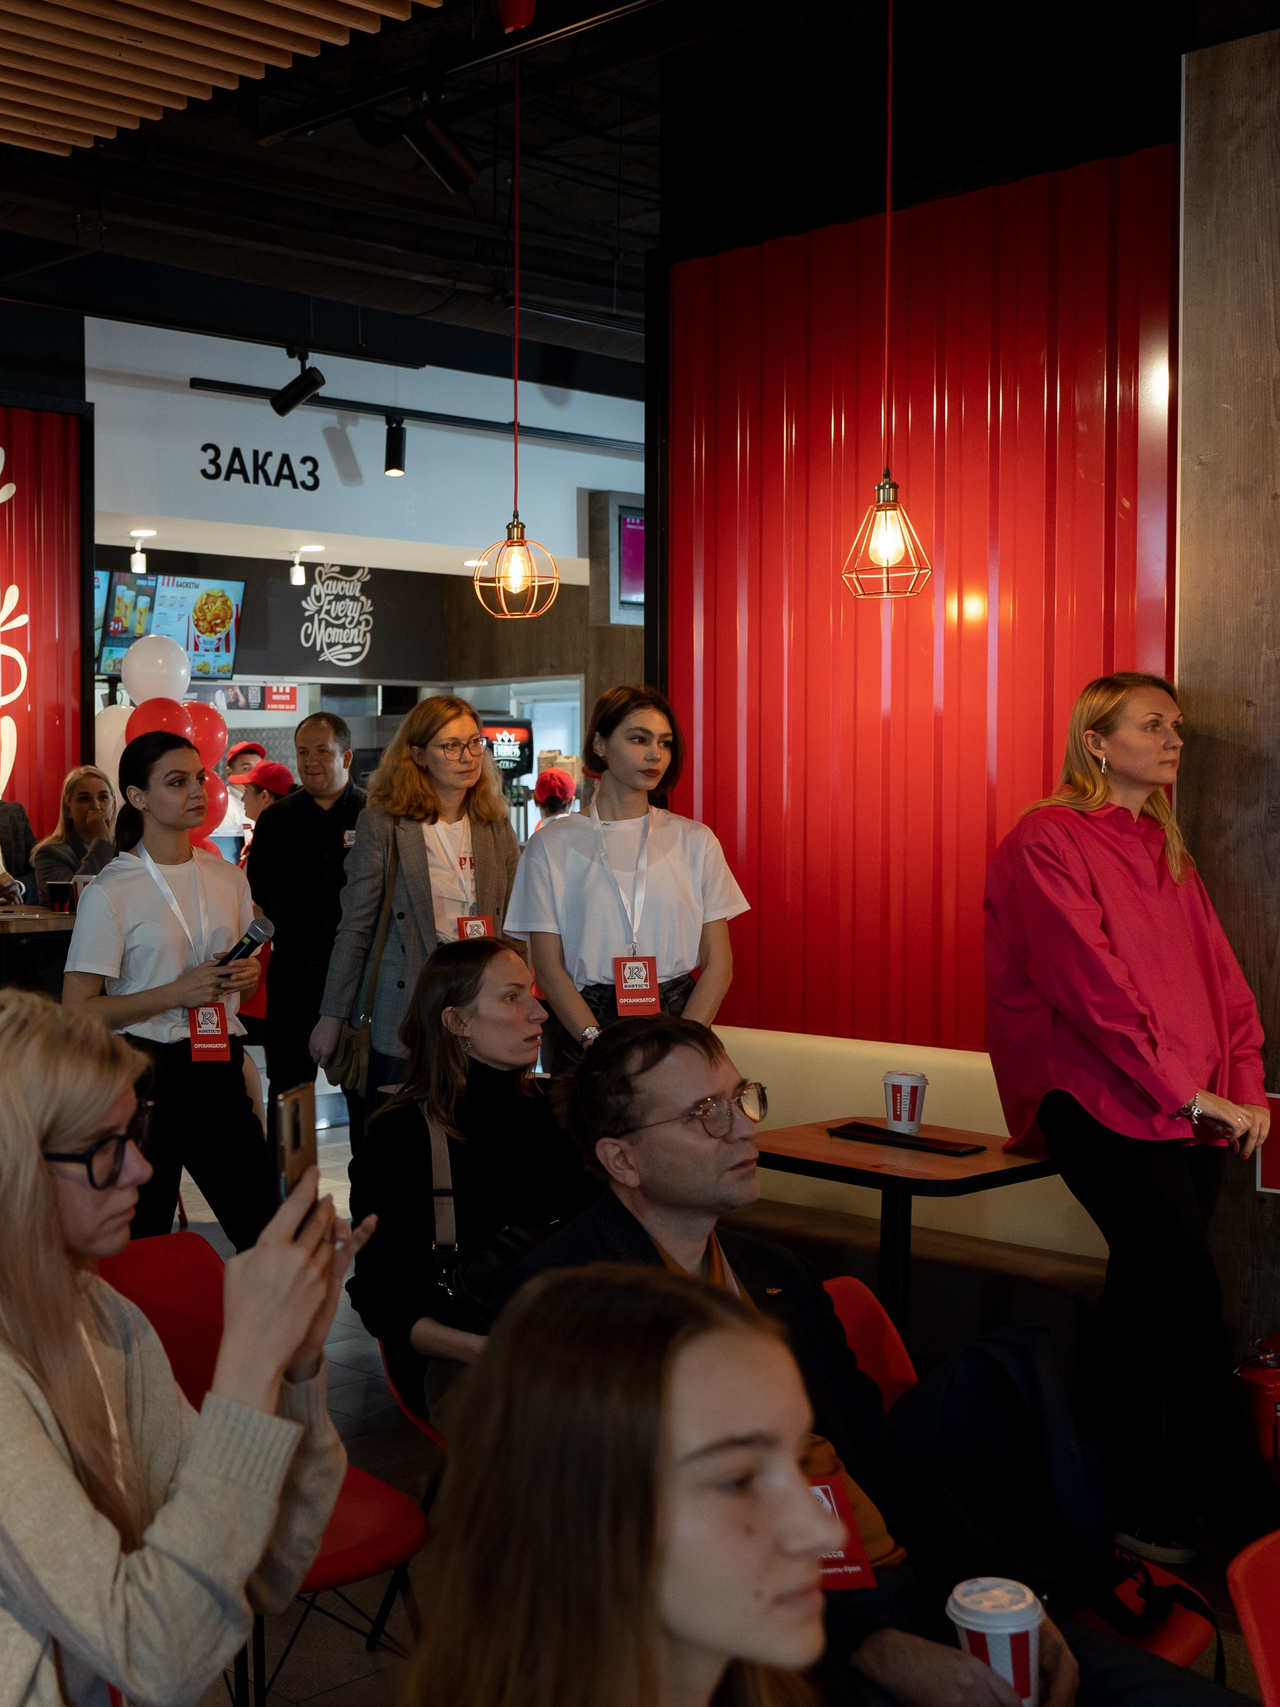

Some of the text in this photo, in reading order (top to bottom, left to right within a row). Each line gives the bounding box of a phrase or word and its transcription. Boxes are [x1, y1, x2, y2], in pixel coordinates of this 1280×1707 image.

[200, 443, 320, 491] ЗАКАЗ
[310, 566, 363, 606] Savour
[109, 621, 122, 631] 2+1
[319, 595, 366, 628] Every
[301, 613, 373, 660] Moment
